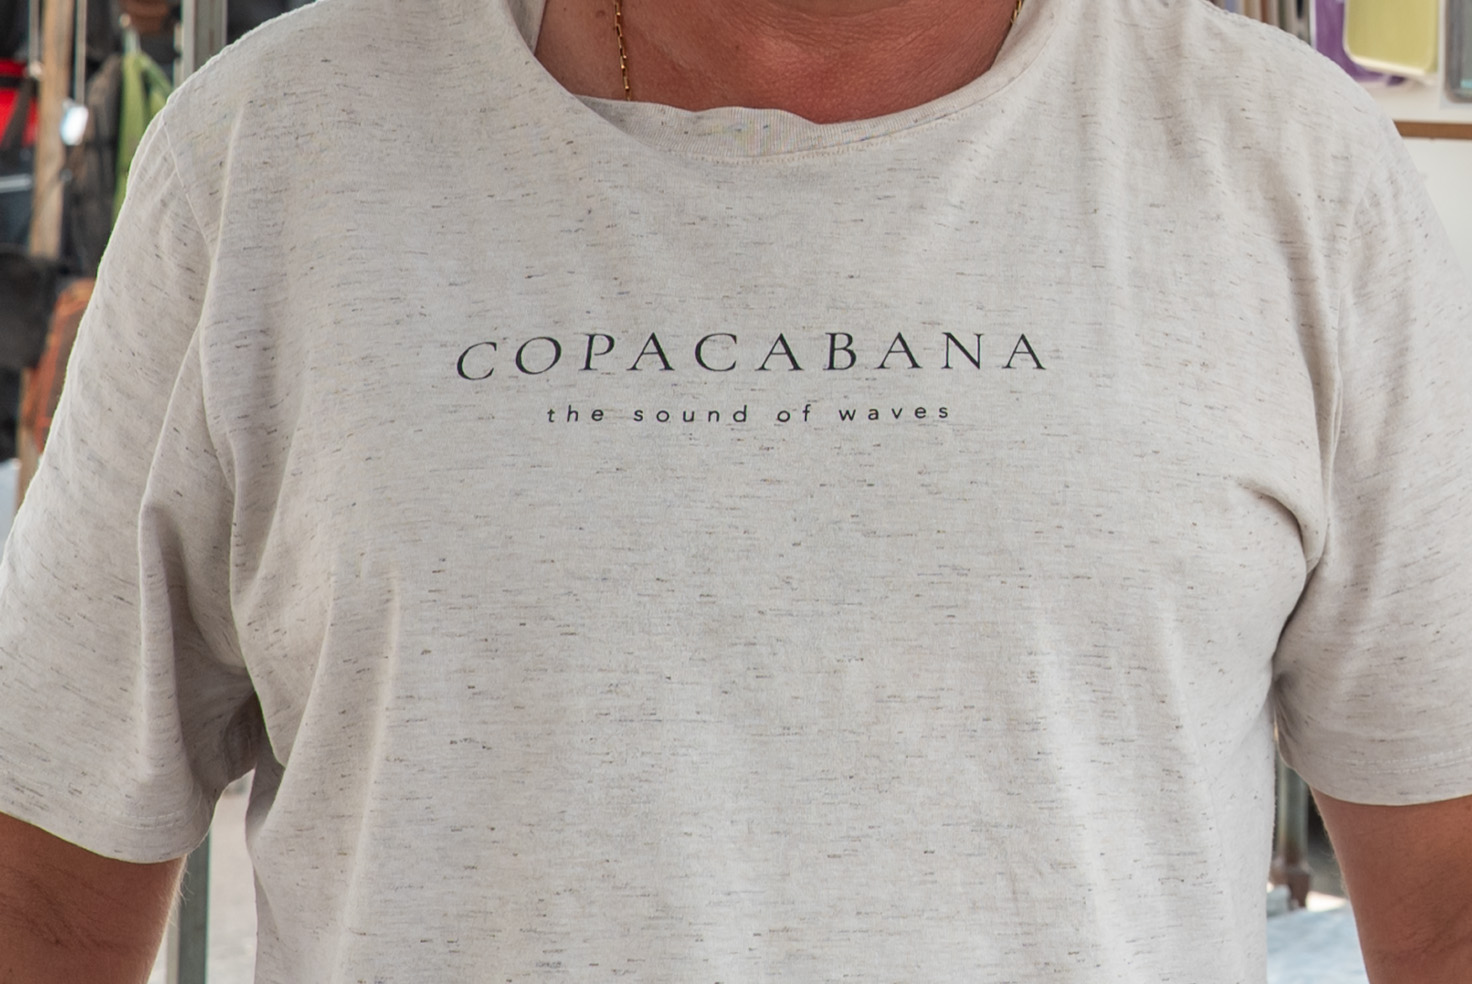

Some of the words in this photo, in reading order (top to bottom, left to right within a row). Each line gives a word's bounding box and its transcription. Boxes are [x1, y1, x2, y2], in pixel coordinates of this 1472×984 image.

[456, 331, 1047, 381] COPACABANA
[547, 404, 605, 423] the
[633, 403, 749, 423] sound
[776, 403, 813, 422] of
[838, 403, 950, 421] waves
